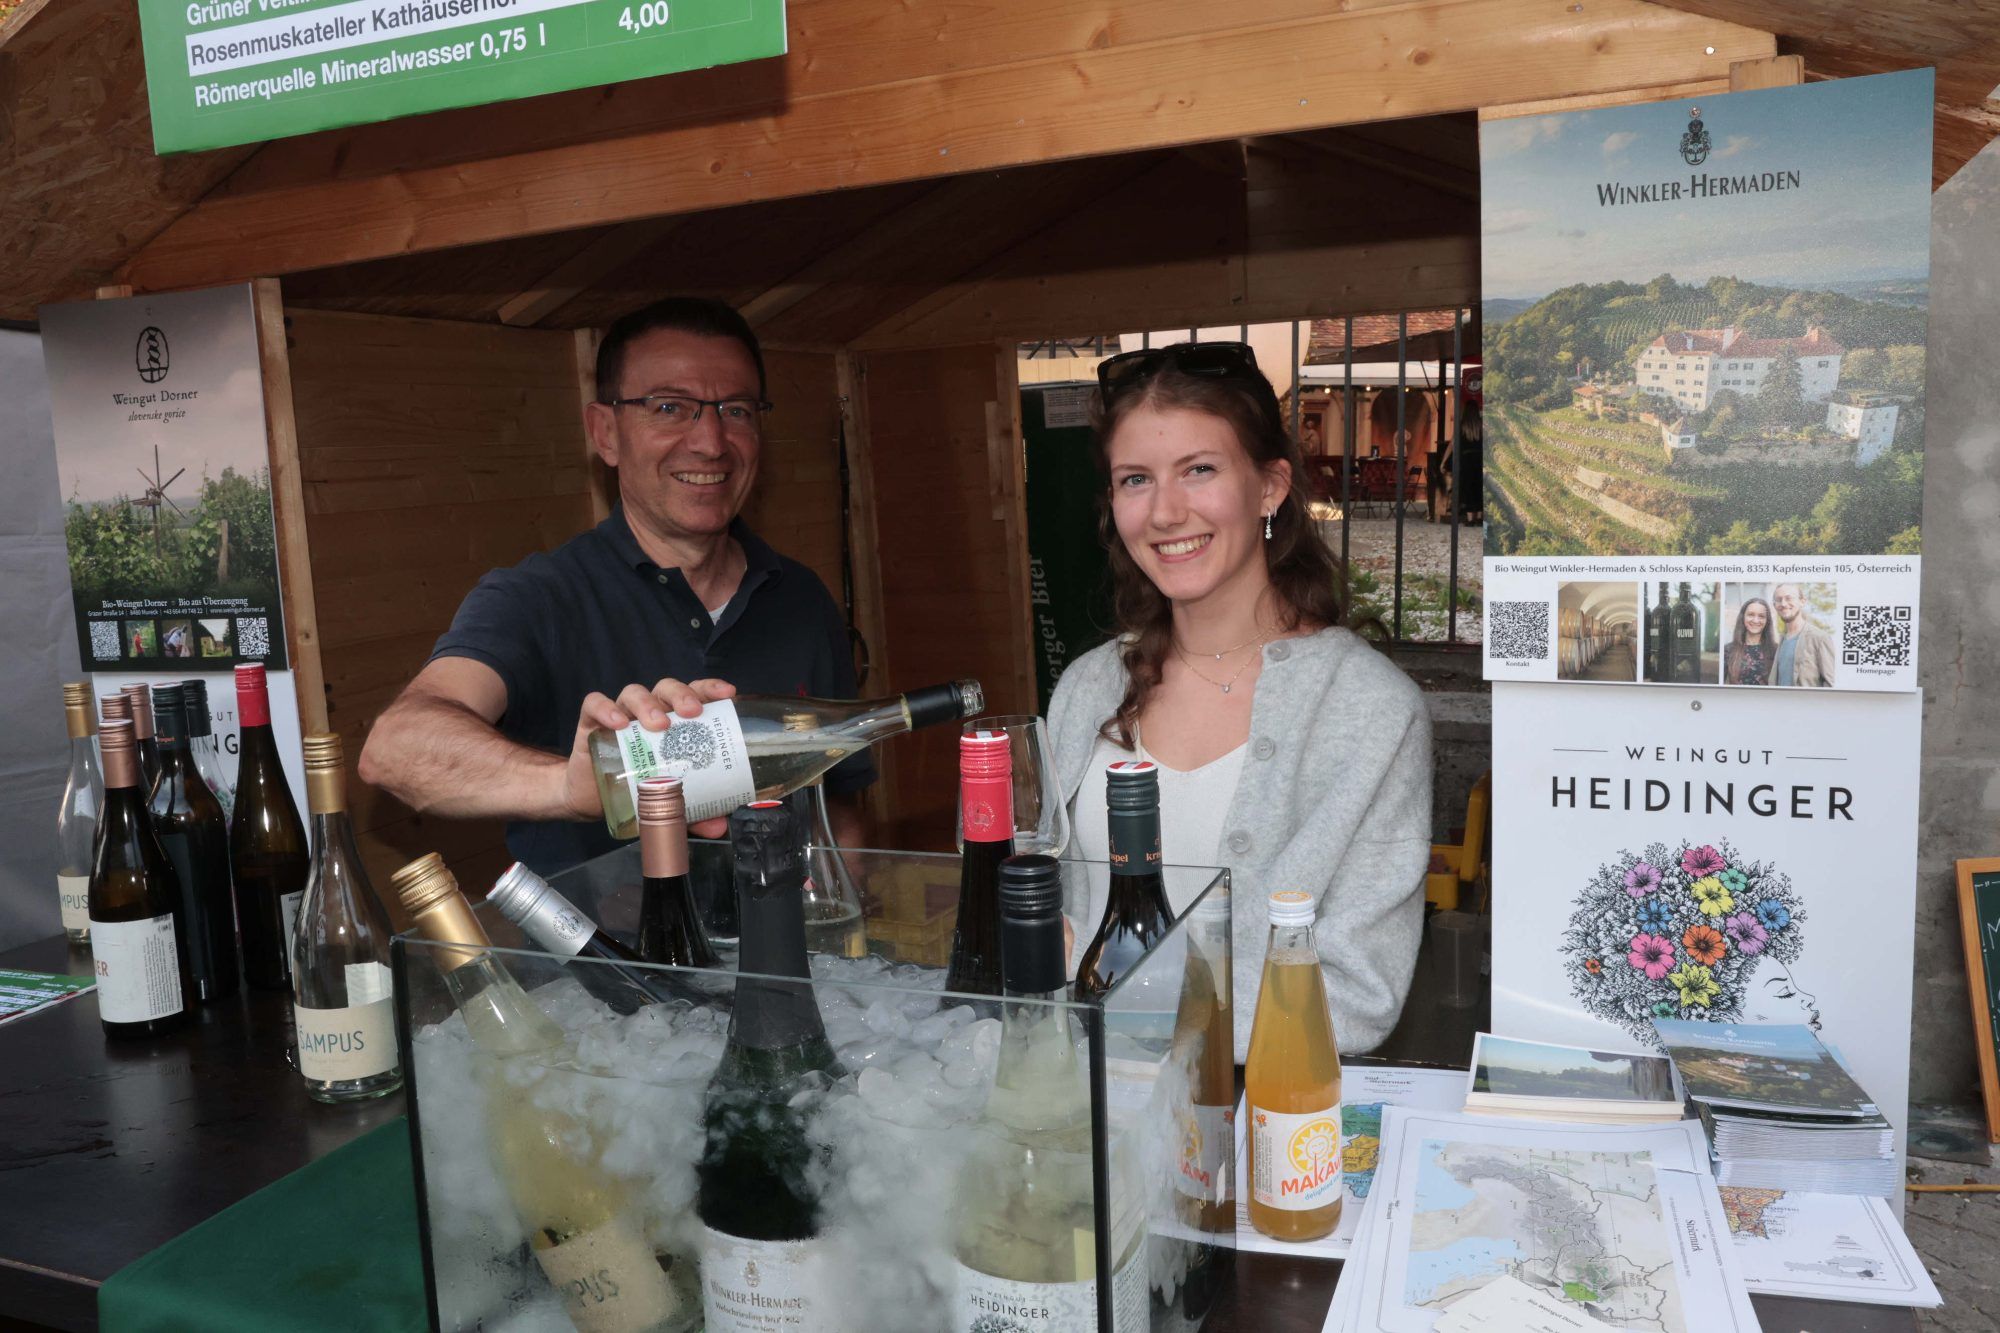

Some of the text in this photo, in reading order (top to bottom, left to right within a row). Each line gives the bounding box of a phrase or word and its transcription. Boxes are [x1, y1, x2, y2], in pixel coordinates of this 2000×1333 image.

[186, 0, 252, 25] Grüner
[190, 0, 518, 66] Rosenmuskateller Kathäuser
[194, 66, 316, 107] Römerquelle
[321, 40, 475, 85] Mineralwasser
[480, 27, 527, 59] 0,75
[618, 0, 670, 34] 4,00
[1597, 168, 1801, 207] WINKLER-HERMADEN
[112, 390, 199, 408] Weingut Dorner
[1030, 555, 1050, 606] Bier
[1494, 563, 1912, 576] Bio Weingut Winkler-Hermaden & Schloss Kapfenstein, 8353 Kapfenstein 105, Österreich
[144, 599, 167, 607] Dorner
[178, 598, 190, 606] Bio
[1856, 667, 1896, 676] Homepage
[712, 716, 733, 771] HEIDINGER
[1625, 745, 1773, 765] WEINGUT
[1552, 775, 1855, 821] HEIDINGER
[299, 1025, 365, 1054] ŠAMPUS
[710, 1279, 803, 1310] WINKLER-HERMADE
[970, 1294, 1049, 1319] HEIDINGER
